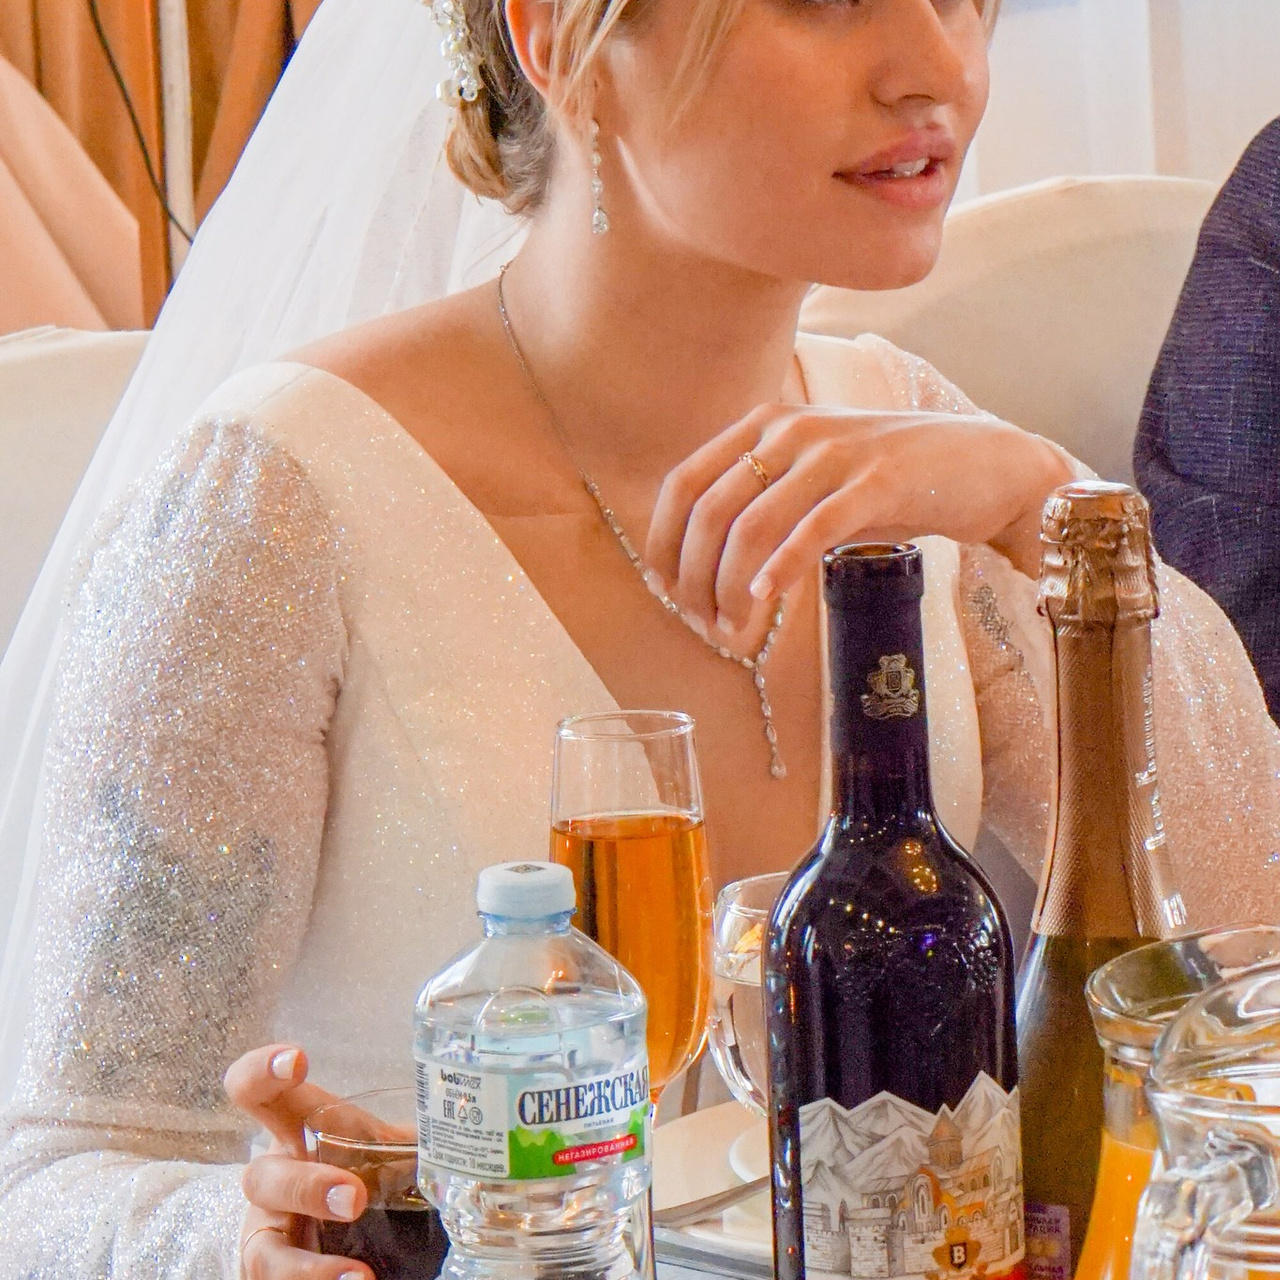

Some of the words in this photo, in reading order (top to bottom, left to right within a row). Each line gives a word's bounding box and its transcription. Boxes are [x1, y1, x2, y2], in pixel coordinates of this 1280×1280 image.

[518, 1064, 649, 1126] СЕНЕЖСКАЯ
[558, 1137, 634, 1162] НЕГАЗИРОВАННАЯ
[953, 1246, 966, 1264] B
